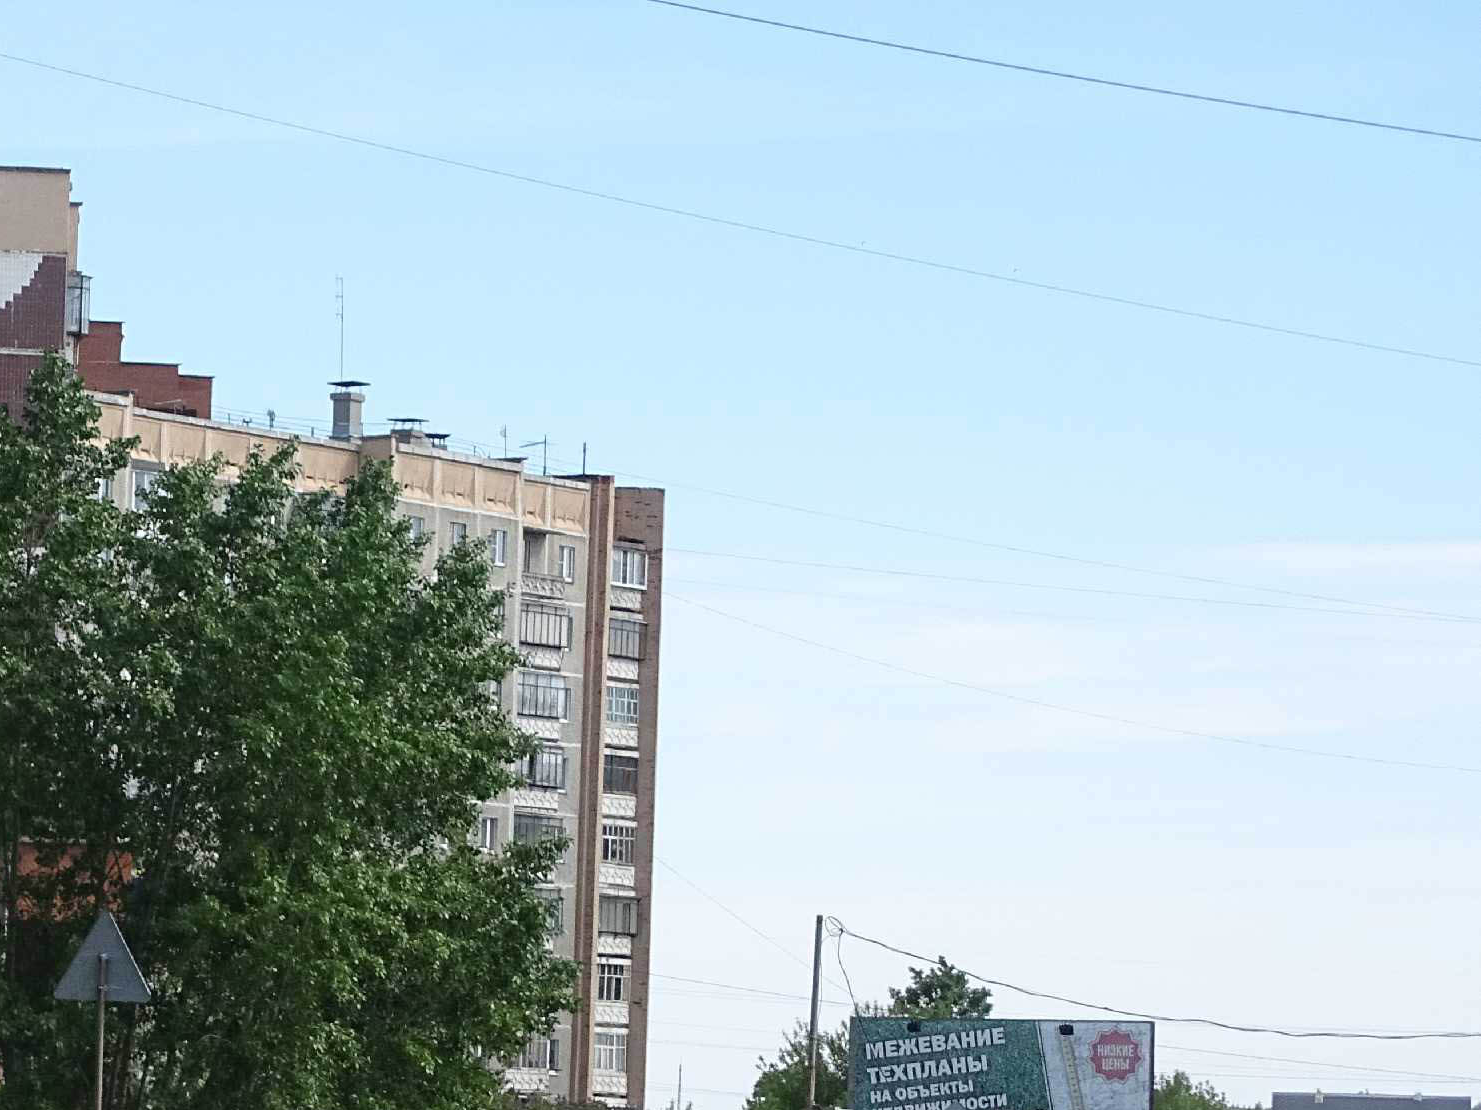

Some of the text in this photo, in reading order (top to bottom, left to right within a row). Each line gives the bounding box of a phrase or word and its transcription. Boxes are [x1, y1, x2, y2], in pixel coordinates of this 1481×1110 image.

[865, 1027, 1006, 1060] МЕЖЕВАНИЕ
[1097, 1044, 1135, 1057] НИЗКИЕ
[866, 1054, 988, 1085] ТЕХПЛАНЫ
[1102, 1058, 1130, 1071] ЦЕНЫ
[870, 1079, 974, 1104] НА ОБЪЕКТЫ
